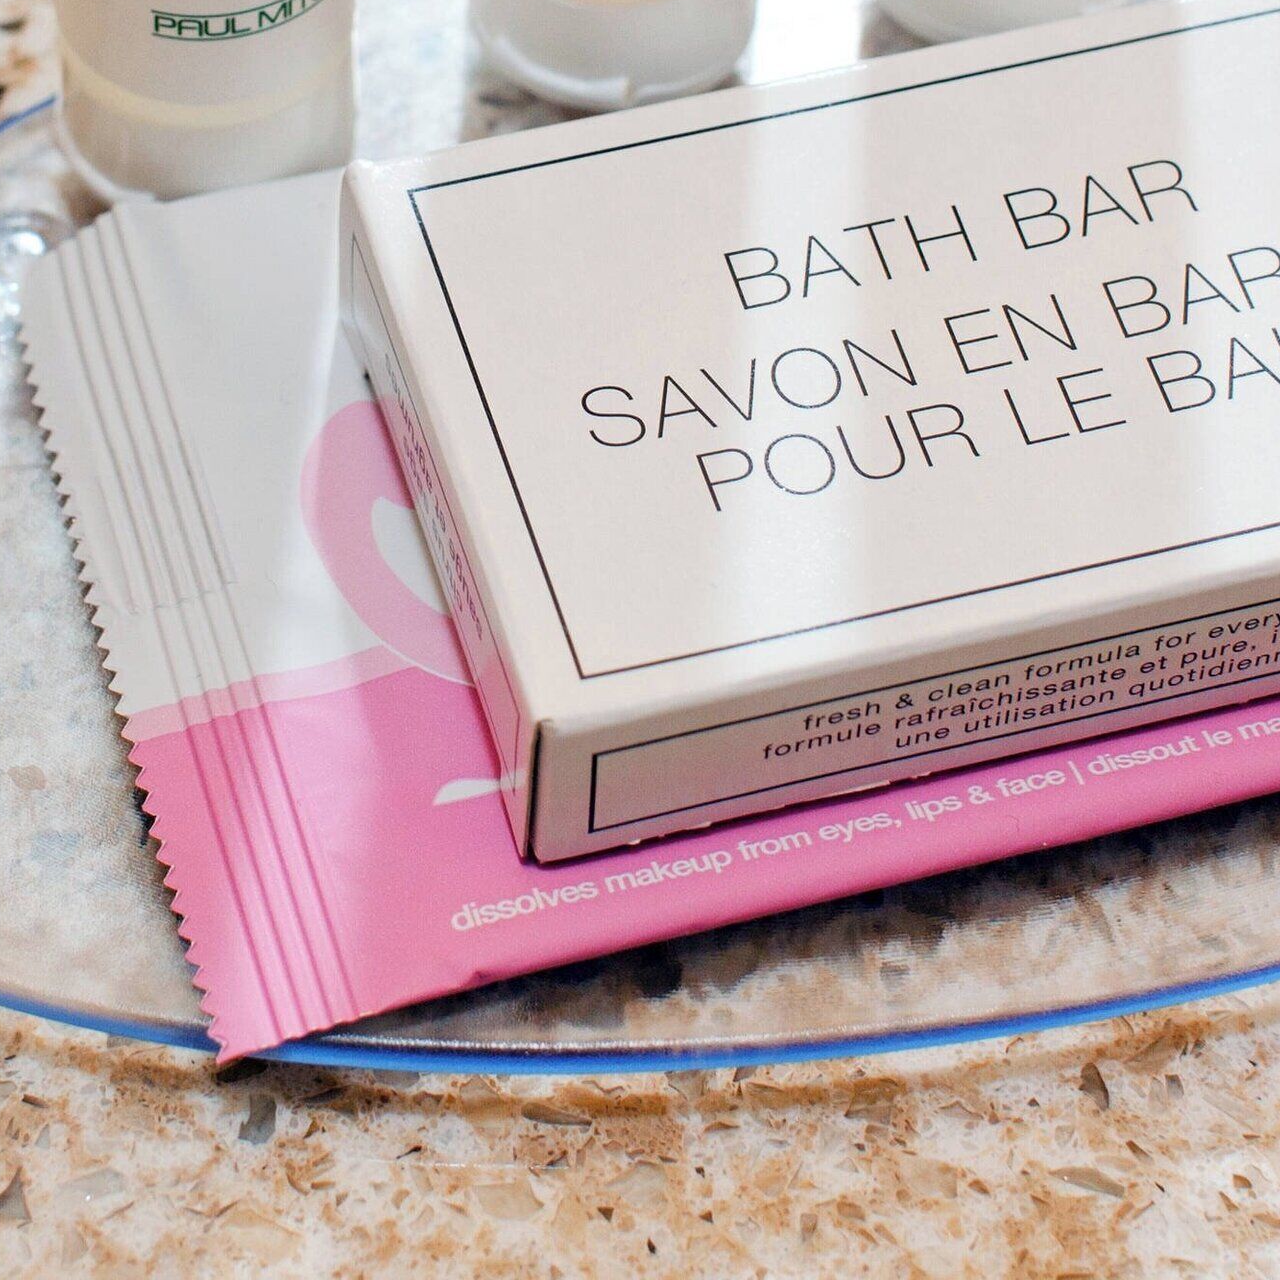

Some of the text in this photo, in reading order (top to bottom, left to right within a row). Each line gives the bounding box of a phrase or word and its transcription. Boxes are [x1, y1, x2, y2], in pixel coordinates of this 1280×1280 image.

[153, 13, 253, 39] PAUL
[724, 159, 1199, 311] BATH BAR
[580, 328, 918, 448] SAVON
[944, 294, 1079, 375] EN
[696, 403, 979, 512] POUR
[1004, 369, 1126, 446] LE
[763, 723, 881, 759] formule
[895, 666, 1126, 729] rafraîchissante
[1140, 656, 1167, 675] et
[804, 701, 880, 731] fresh
[895, 693, 914, 709] &
[928, 672, 1010, 702] clean
[1024, 643, 1141, 681] formula
[1154, 630, 1196, 652] for
[896, 727, 950, 748] une
[964, 689, 1114, 734] utilisation
[450, 882, 599, 932] dissolves
[604, 847, 732, 894] makeup
[737, 830, 812, 862] from
[818, 803, 901, 842] eyes,
[906, 794, 963, 822] lips
[967, 784, 995, 806] &
[995, 767, 1066, 797] face
[1086, 734, 1202, 777] dissout
[1205, 726, 1234, 747] le
